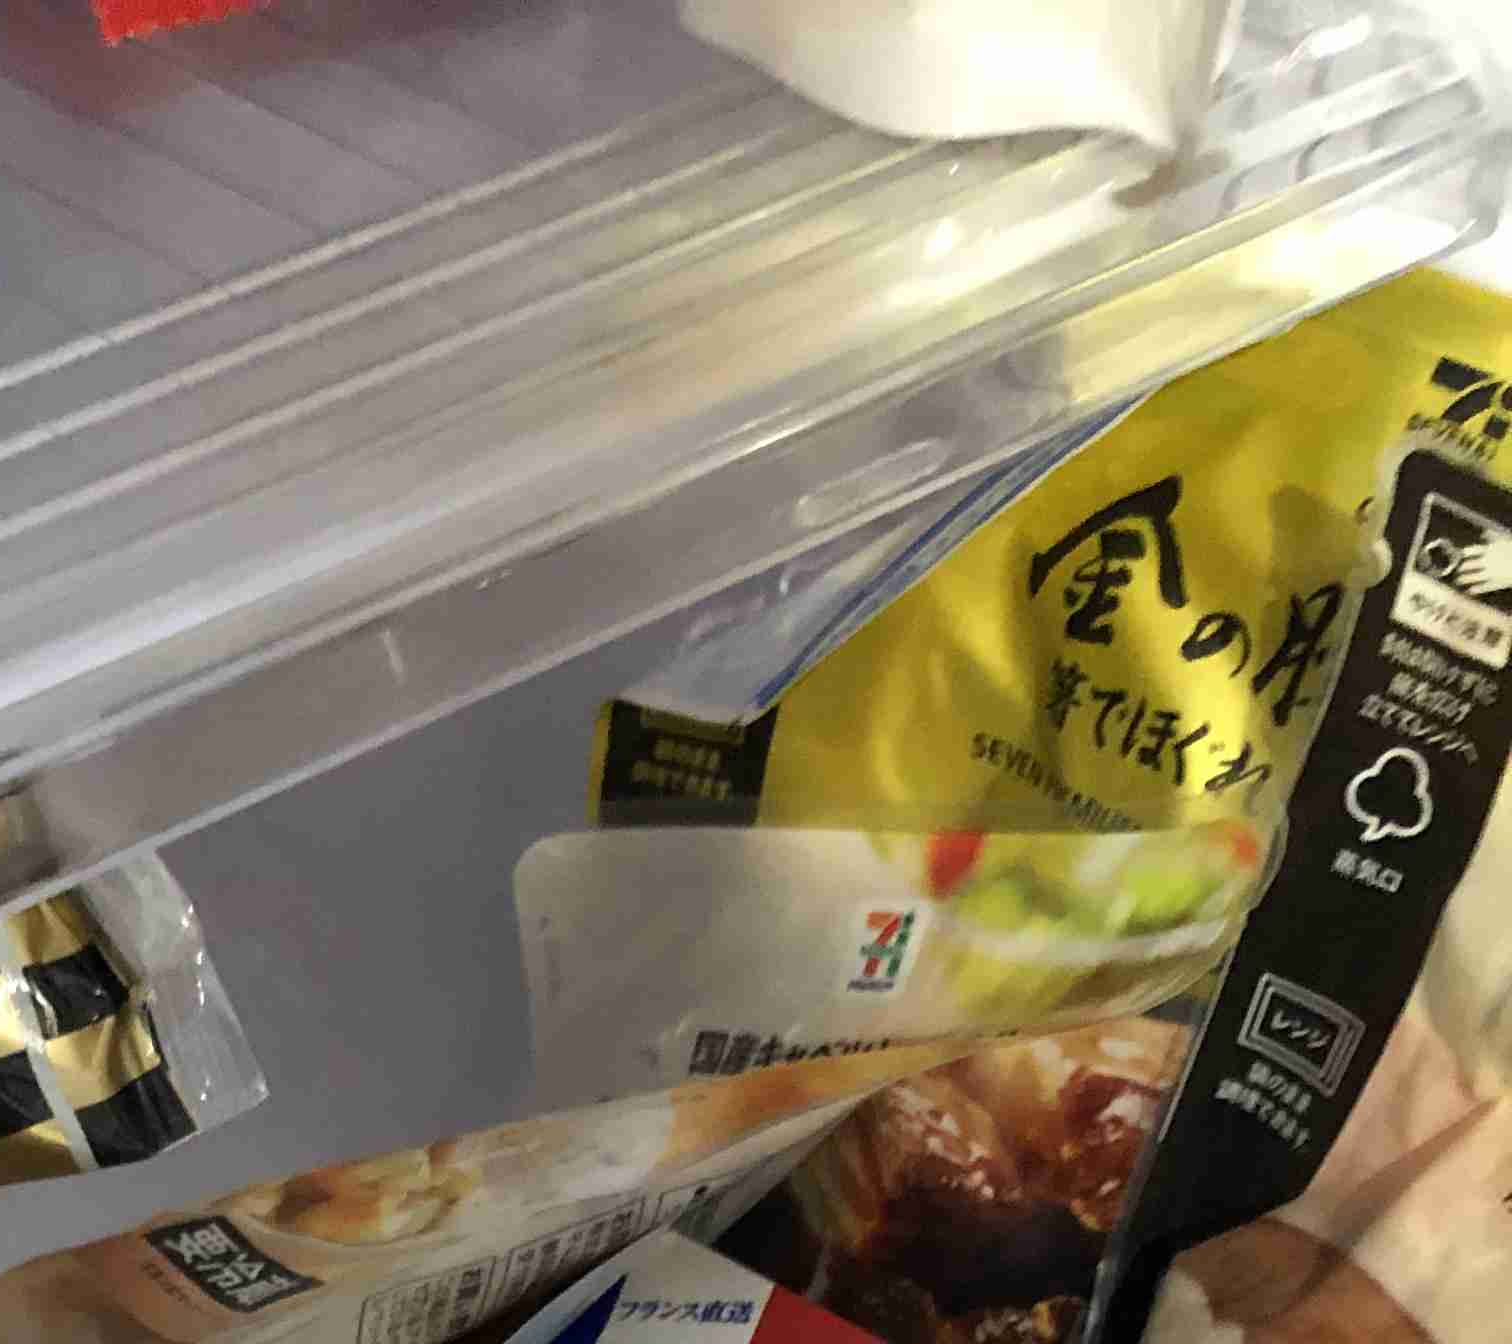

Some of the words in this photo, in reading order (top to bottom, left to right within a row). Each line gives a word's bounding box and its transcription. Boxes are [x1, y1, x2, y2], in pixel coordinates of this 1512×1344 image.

[615, 1299, 754, 1325] フランス直送
